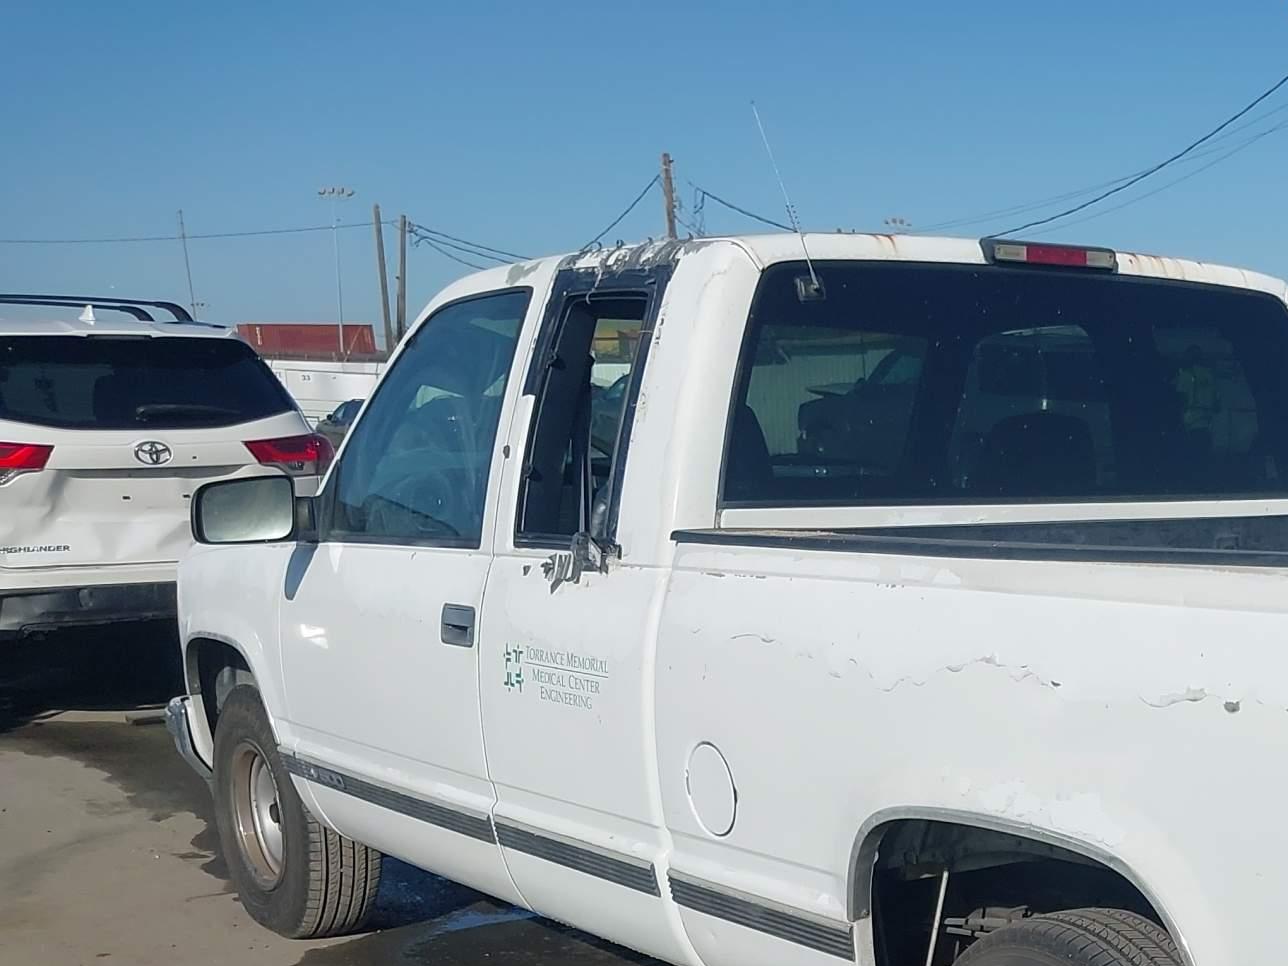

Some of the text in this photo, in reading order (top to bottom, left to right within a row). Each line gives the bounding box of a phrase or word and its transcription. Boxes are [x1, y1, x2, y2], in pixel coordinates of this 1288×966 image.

[526, 645, 609, 674] TORRANCE MEMORIAL
[532, 668, 600, 694] MEDICAL CENTER
[540, 686, 593, 710] ENGINEERING
